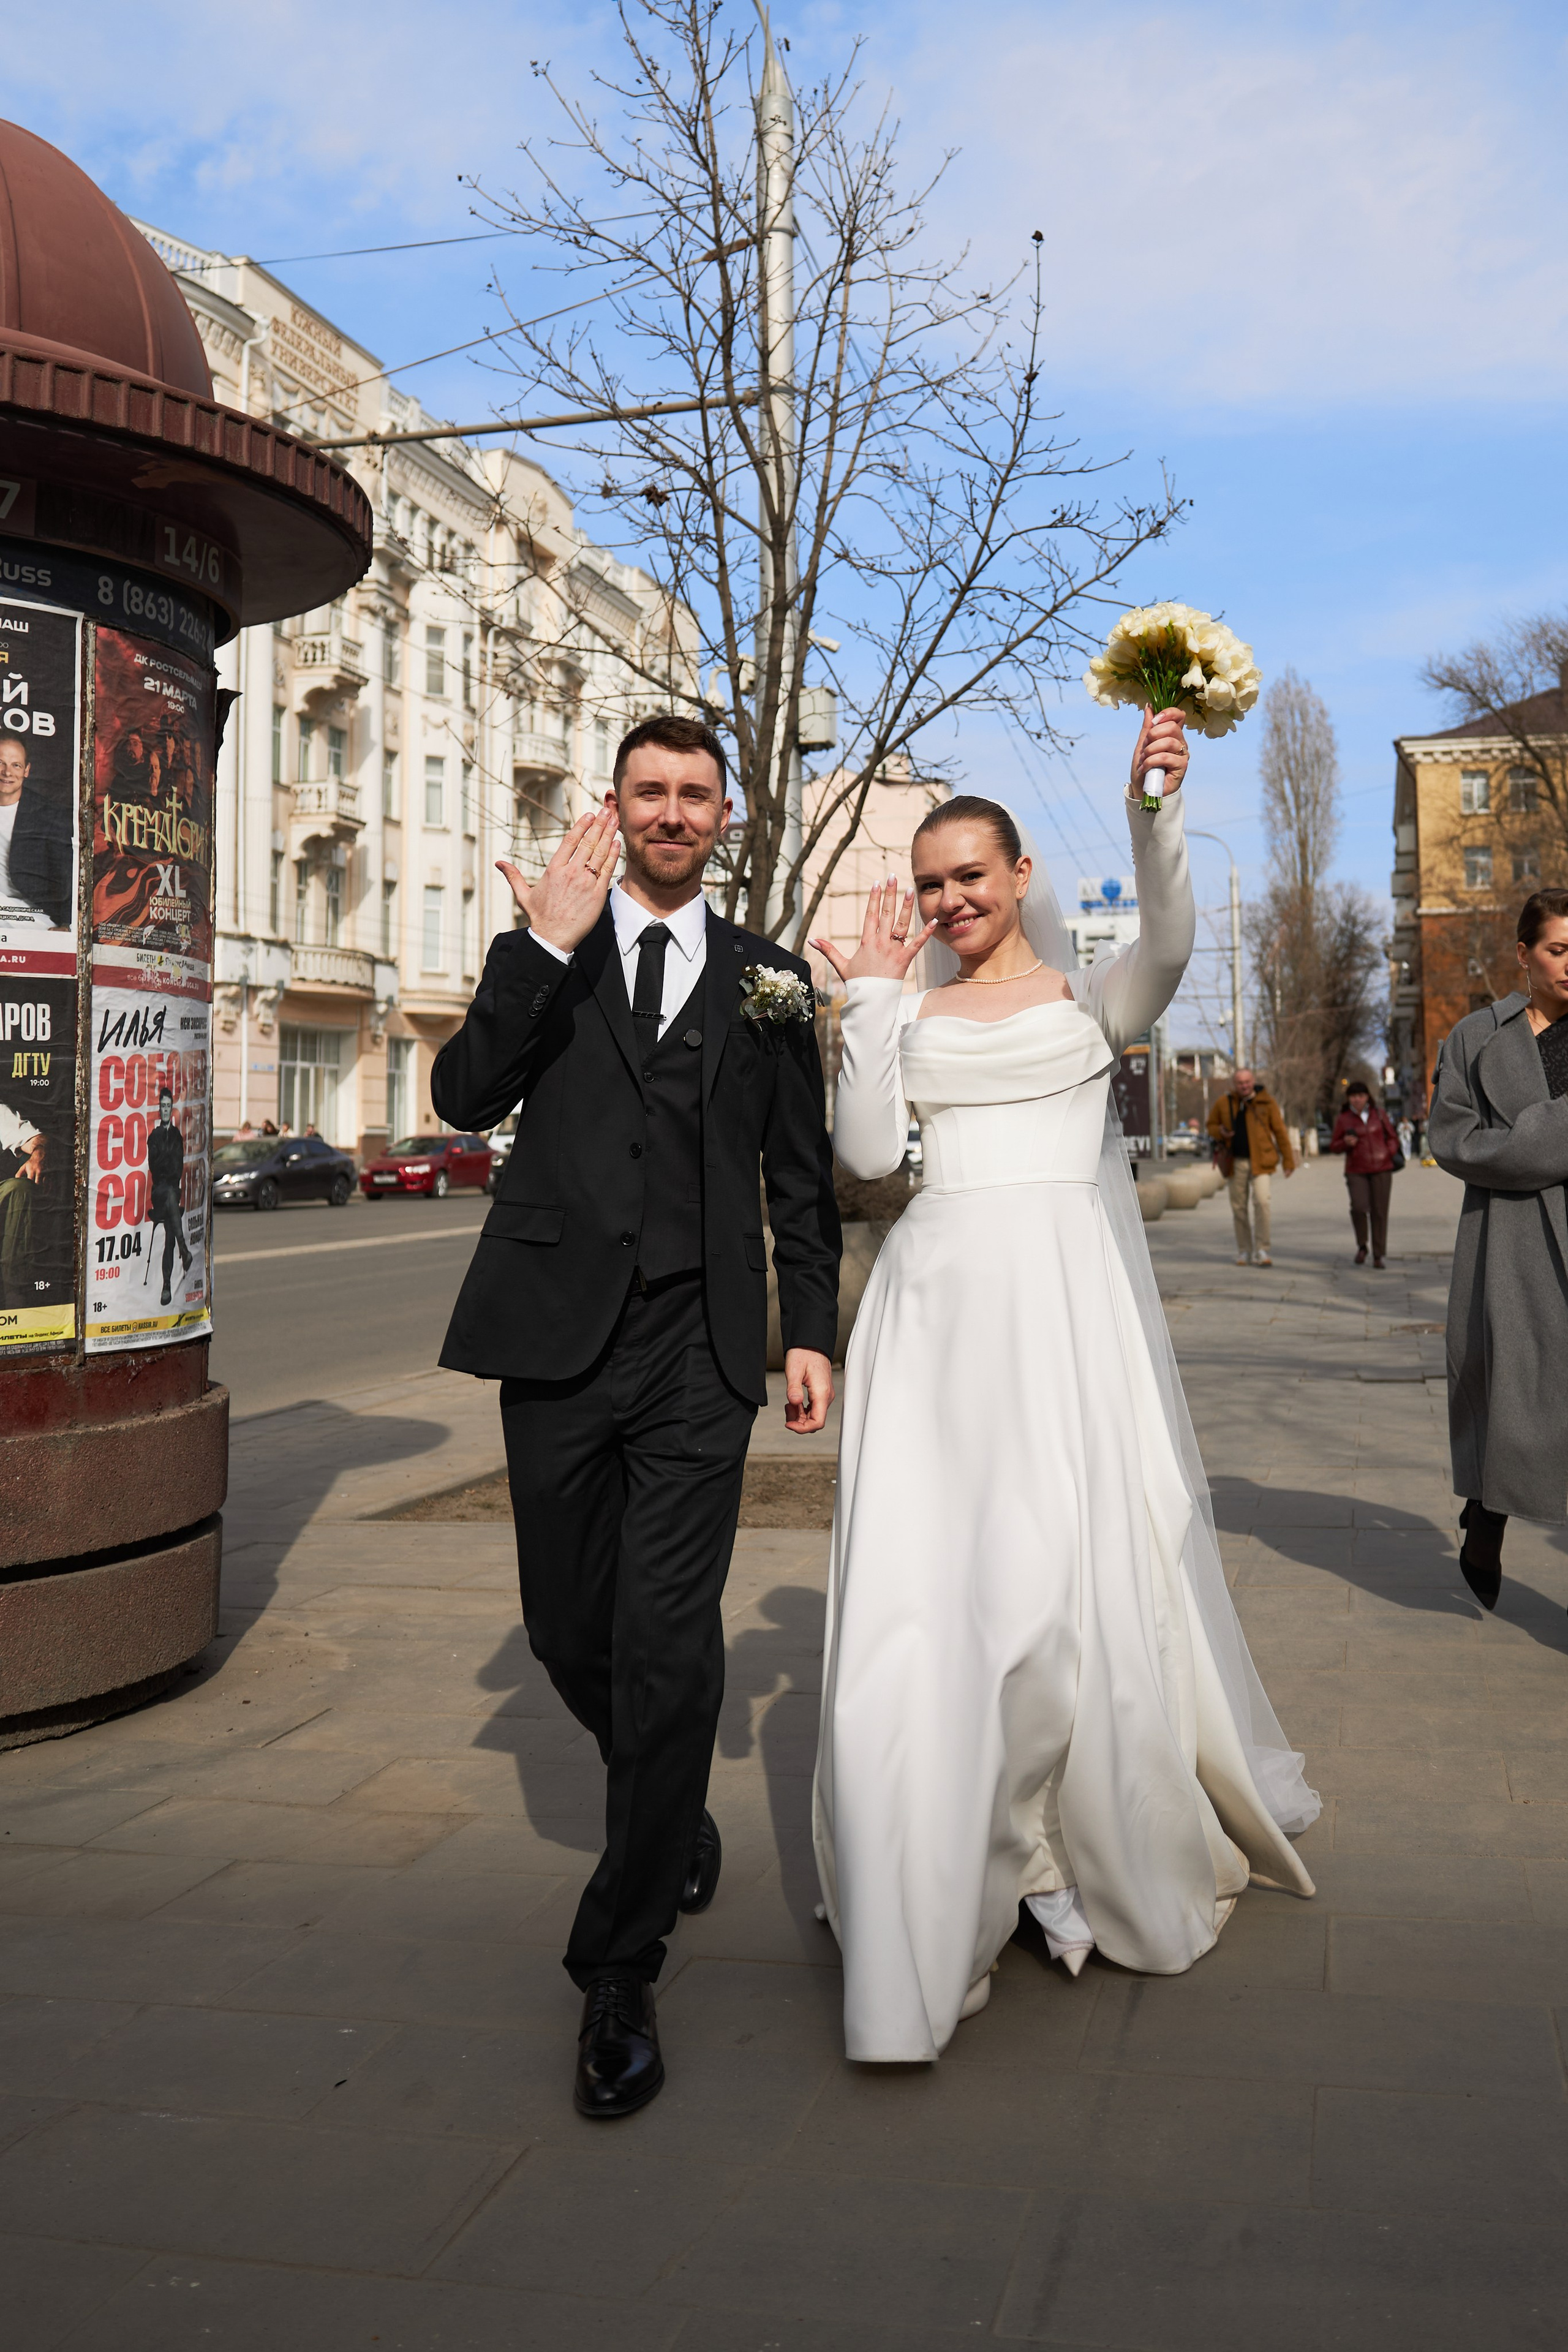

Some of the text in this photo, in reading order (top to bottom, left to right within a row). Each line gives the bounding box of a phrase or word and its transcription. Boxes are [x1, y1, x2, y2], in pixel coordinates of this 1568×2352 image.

[164, 526, 220, 583] 14/6
[0, 559, 51, 587] USS
[97, 575, 114, 605] 8
[123, 579, 174, 631] (863)
[0, 618, 29, 633] АШ
[134, 654, 202, 690] ДК РОСТСЕЛЬМАШ
[143, 676, 197, 710] 21 МАРТА
[167, 701, 184, 714] 19:00
[0, 707, 56, 736] ОВ
[104, 786, 209, 867] КРЕМАТОРИЙ
[156, 864, 186, 898] XL
[149, 896, 191, 910] ЮБИЛЕЙНЫЙ
[149, 906, 191, 923] КОНЦЕРТ
[0, 1003, 51, 1041] РОВ
[97, 1005, 167, 1053] ИЛЬЯ
[12, 1052, 51, 1078] ДГТУ
[99, 1049, 207, 1111] СОБОЛЕВ
[97, 1103, 206, 1170] СОЛЕВ
[95, 1158, 206, 1230] СОЛЕВ
[96, 1232, 142, 1262] 17.04
[34, 1281, 50, 1291] 18+
[95, 1266, 120, 1281] 19:00
[93, 1302, 107, 1313] 18+
[111, 1324, 131, 1333] БИЛЕТЫ
